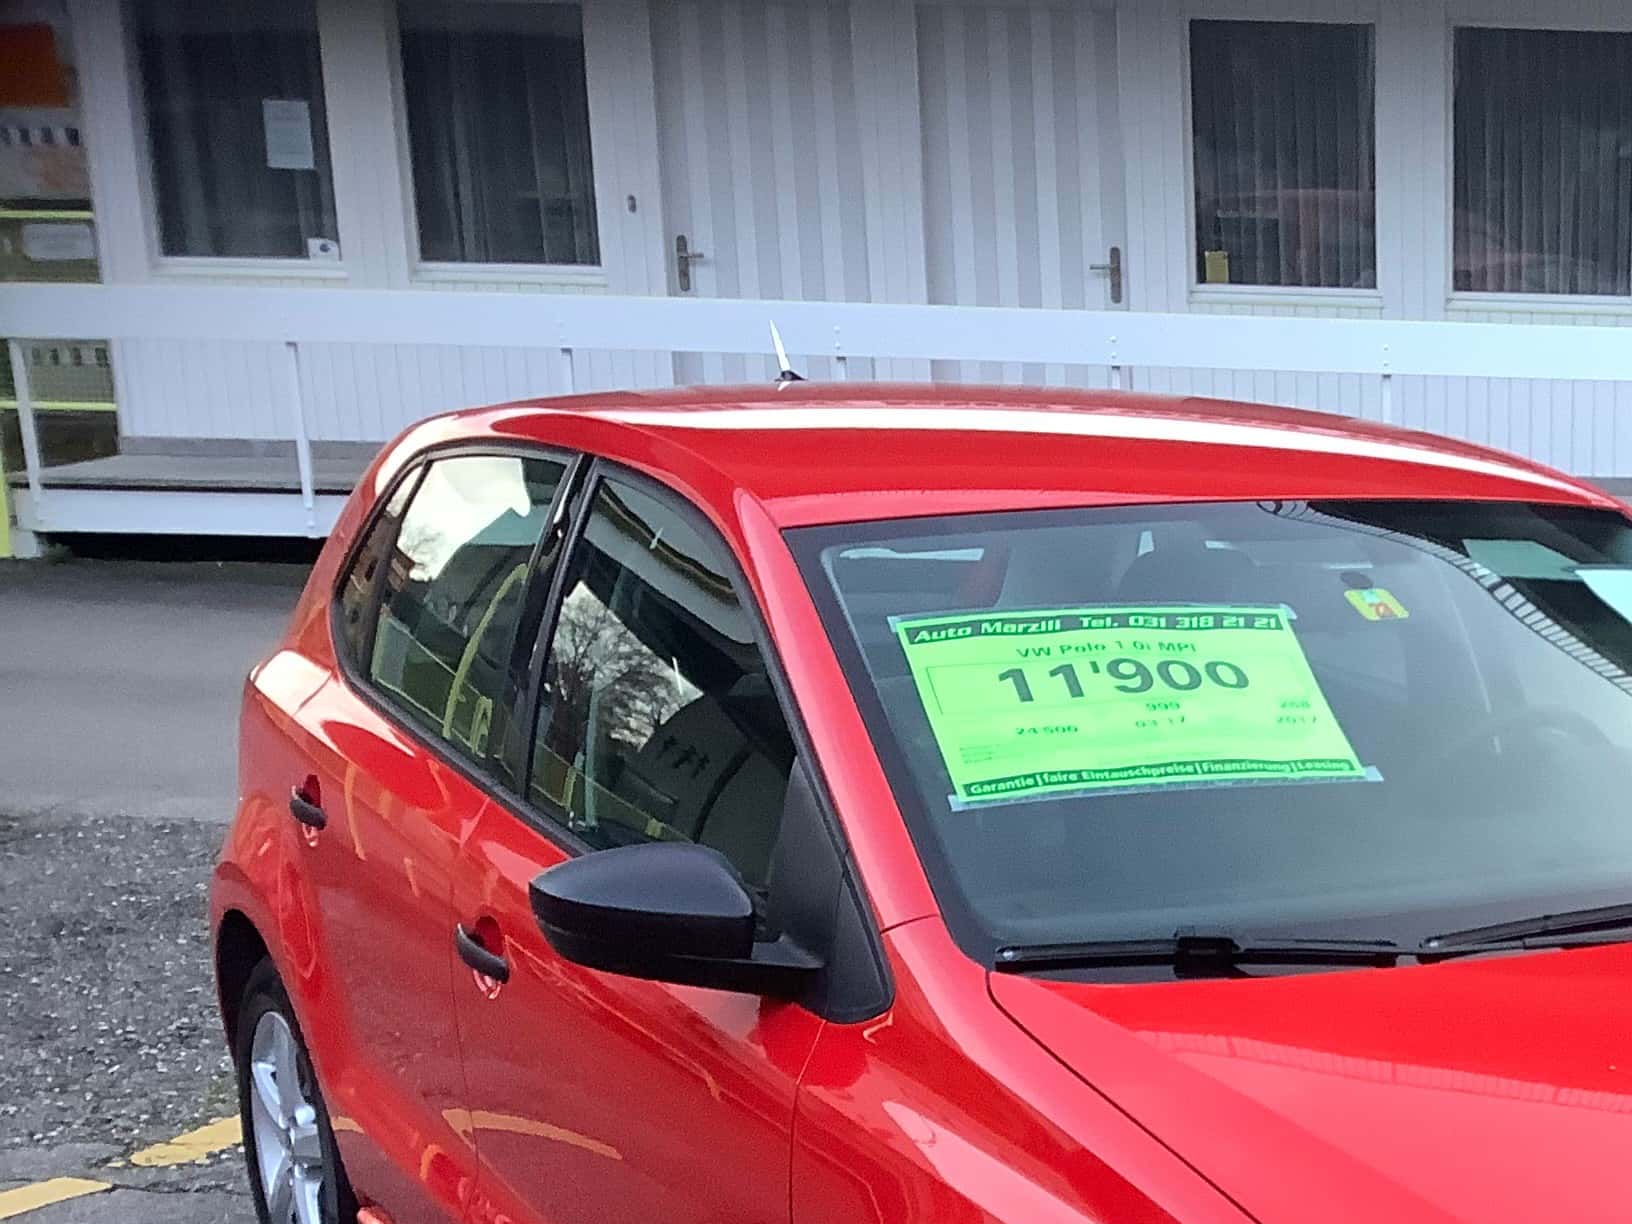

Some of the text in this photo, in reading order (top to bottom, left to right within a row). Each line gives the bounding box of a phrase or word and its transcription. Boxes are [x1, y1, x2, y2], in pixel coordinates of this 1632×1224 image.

[914, 615, 1276, 643] Auto Marzili Tel. 031 318 21 21
[1060, 641, 1106, 655] Polo
[998, 657, 1250, 703] 11'900
